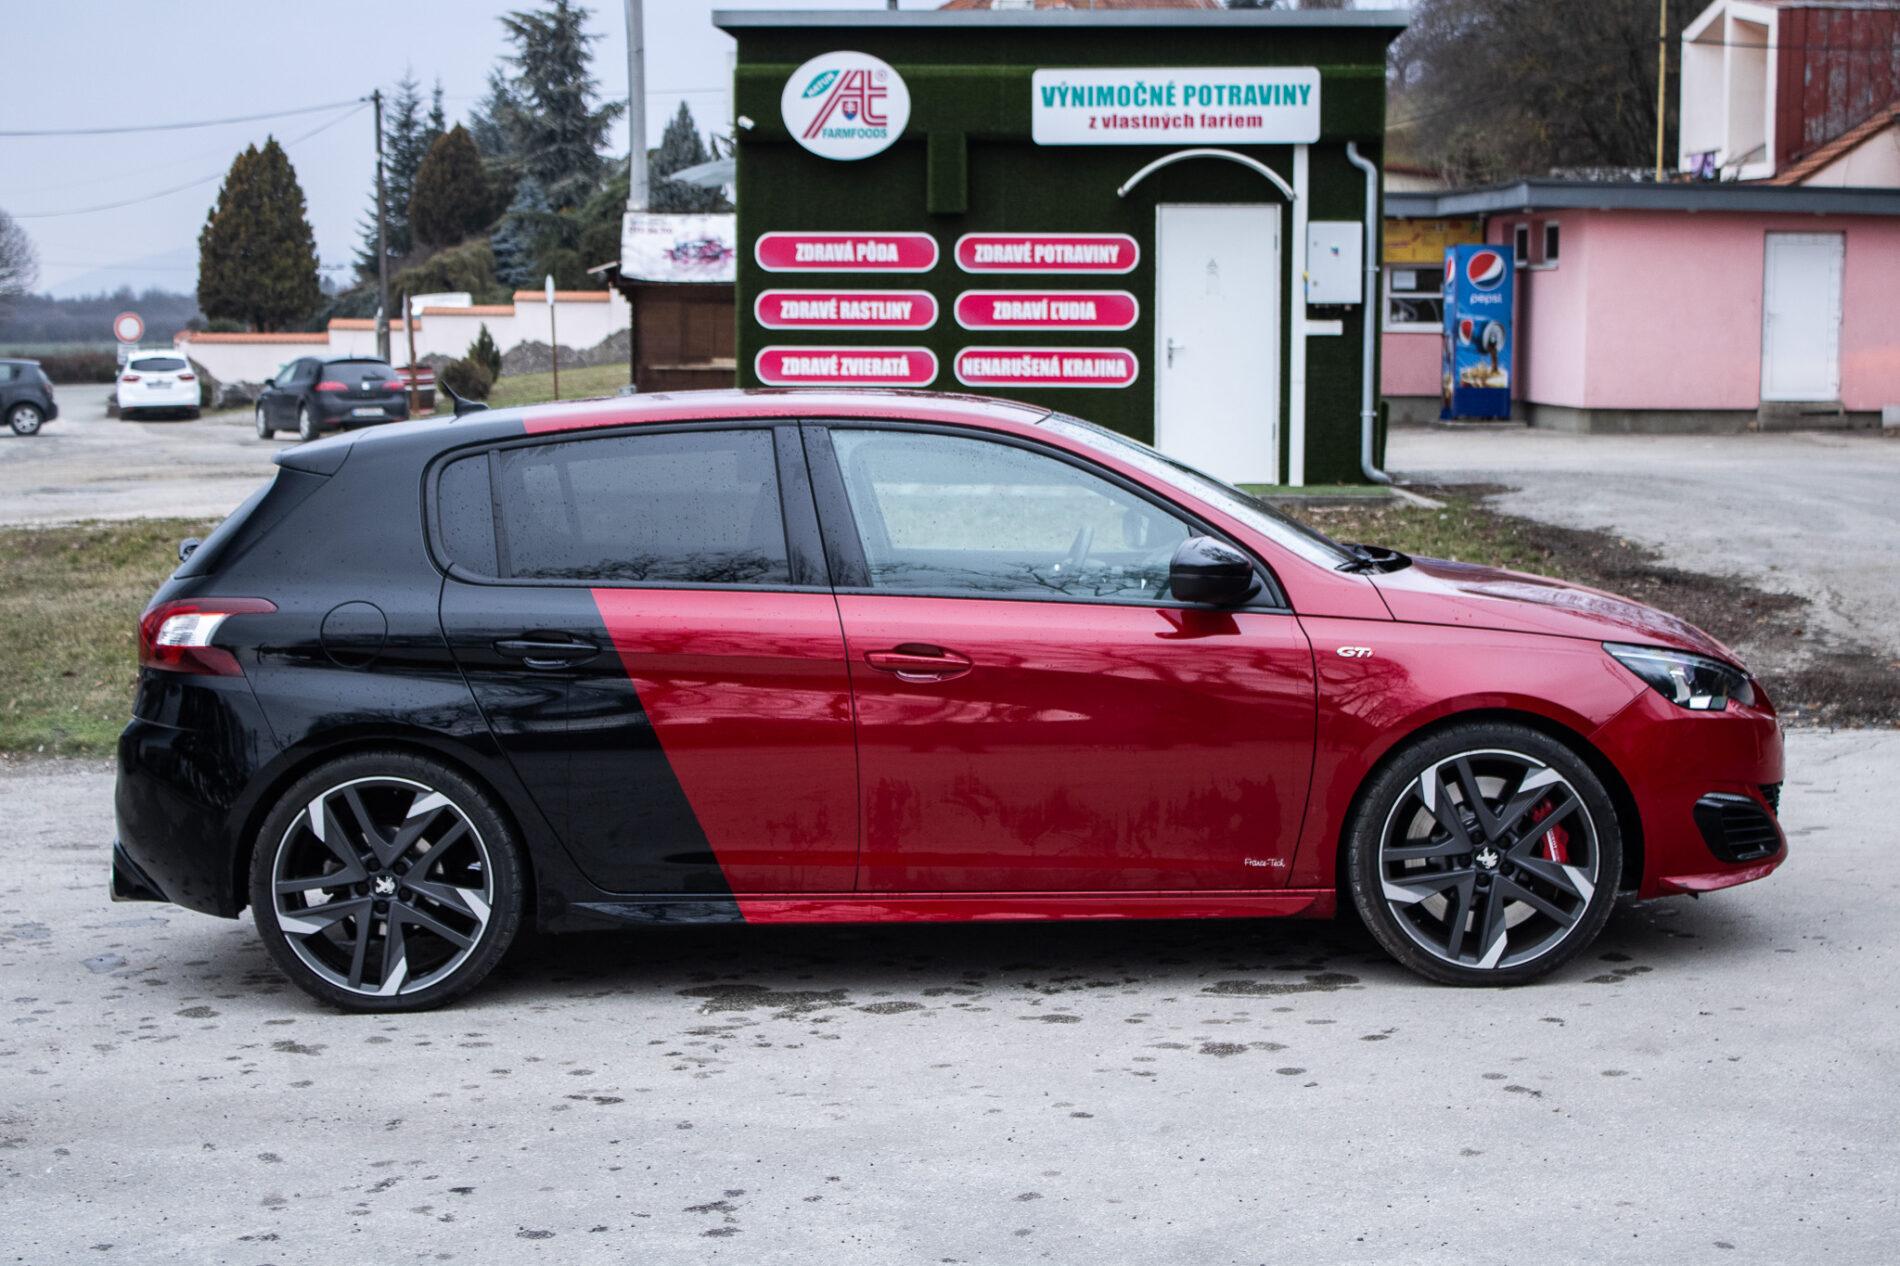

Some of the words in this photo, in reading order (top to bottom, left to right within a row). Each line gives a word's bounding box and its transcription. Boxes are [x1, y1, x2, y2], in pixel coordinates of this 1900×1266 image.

[1041, 80, 1176, 107] VÝNIMOČNÉ
[1183, 84, 1311, 106] POTRAVINY
[1089, 116, 1096, 129] z
[1102, 112, 1194, 130] vlastných
[1200, 114, 1262, 128] fariem
[822, 128, 887, 138] FARMFOODS
[795, 240, 855, 262] ZDRAVÁ
[856, 240, 899, 262] PÔDA
[974, 241, 1032, 263] ZDRAVÉ
[1034, 244, 1120, 263] POTRAVINY
[780, 298, 838, 319] ZDRAVÉ
[840, 301, 912, 320] RASTLINY
[993, 298, 1048, 320] ZDRAVÍ
[1469, 293, 1503, 305] pepsi
[781, 354, 838, 376] ZDRAVÉ
[840, 355, 911, 376] ZVIERATÁ
[961, 355, 1061, 377] NENARUŠENÁ
[1062, 359, 1127, 377] KRAJINA
